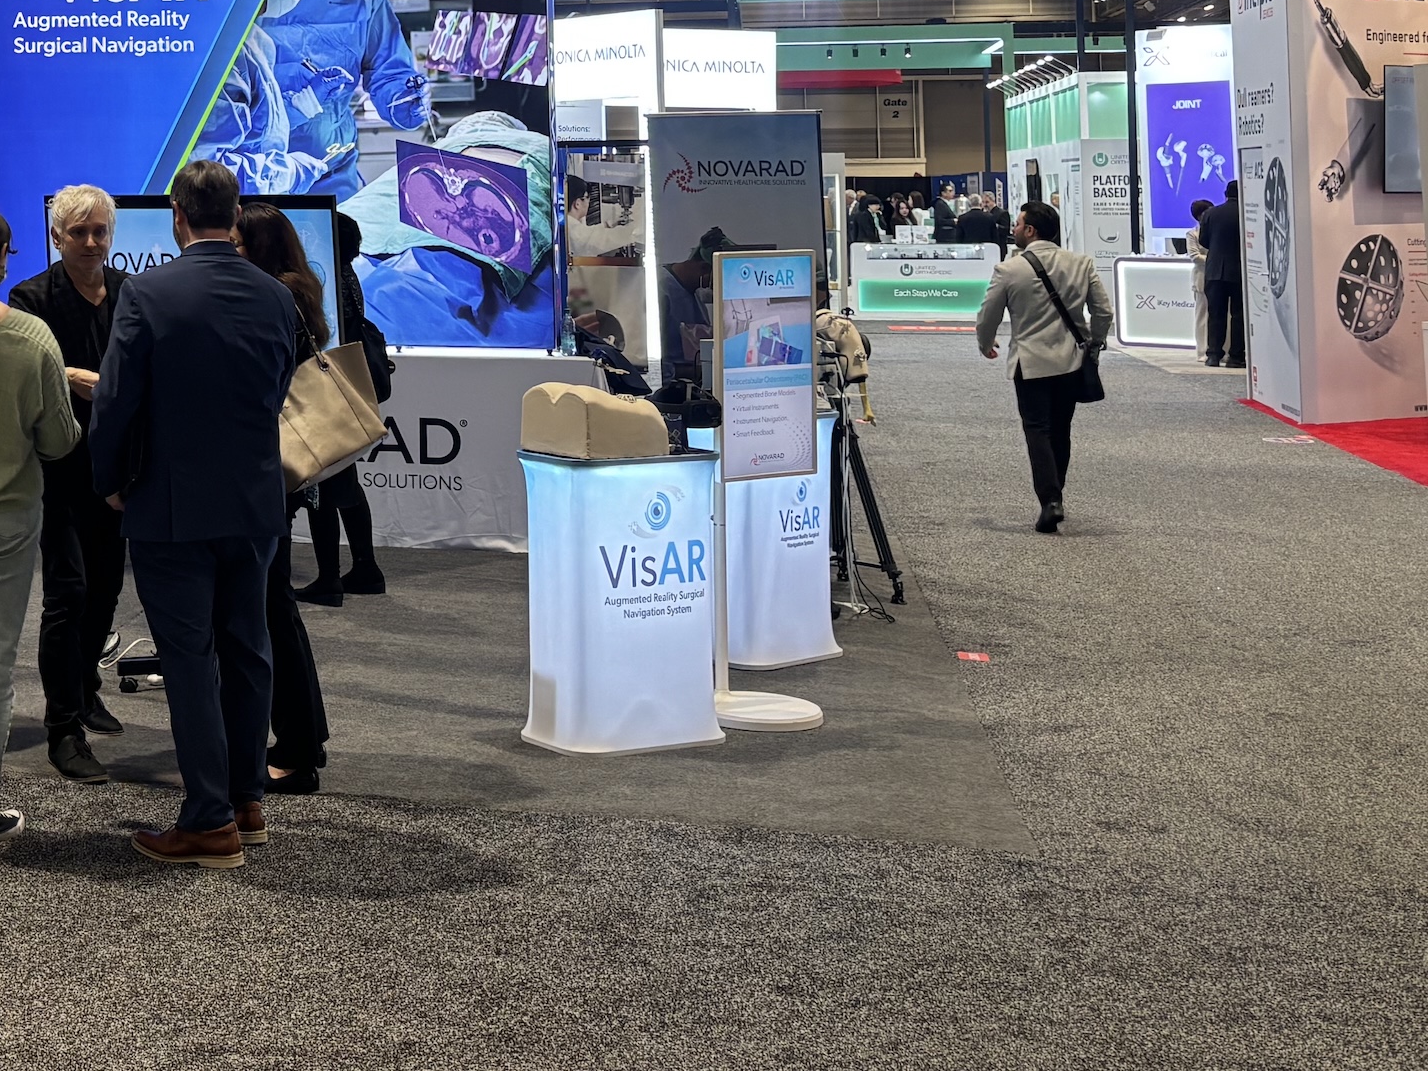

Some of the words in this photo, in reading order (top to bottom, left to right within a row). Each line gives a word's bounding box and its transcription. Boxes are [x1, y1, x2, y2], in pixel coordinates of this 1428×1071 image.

[13, 11, 122, 32] Augmented
[128, 10, 190, 30] Reality
[1366, 29, 1420, 44] Engineered
[13, 37, 86, 57] Surgical
[91, 37, 194, 57] Navigation
[594, 43, 645, 61] MINOLTA
[703, 60, 765, 73] MINOLTA
[1237, 87, 1247, 108] Dull
[1248, 82, 1274, 107] reamers?
[883, 98, 908, 109] Gate
[1172, 99, 1202, 109] JOINT
[891, 110, 900, 118] 2
[1238, 113, 1264, 136] Robotics?
[697, 160, 805, 177] NOVARAD
[1093, 187, 1126, 198] BASED
[754, 269, 794, 287] VisAR
[894, 288, 911, 296] Each
[912, 289, 928, 297] Step
[941, 289, 958, 297] Care
[736, 392, 764, 400] Segmented
[778, 389, 796, 397] Models
[752, 403, 779, 411] Instruments
[762, 416, 788, 424] Navigation
[736, 430, 750, 438] Smart
[751, 428, 774, 436] Feedback
[363, 472, 463, 491] SOLUTIONS
[778, 505, 820, 533] VisAR
[599, 539, 707, 589] VisAR
[604, 593, 652, 607] Augmented
[653, 592, 677, 602] Reality
[679, 588, 705, 601] Surgical
[623, 607, 665, 619] Navigation
[666, 605, 692, 616] System
